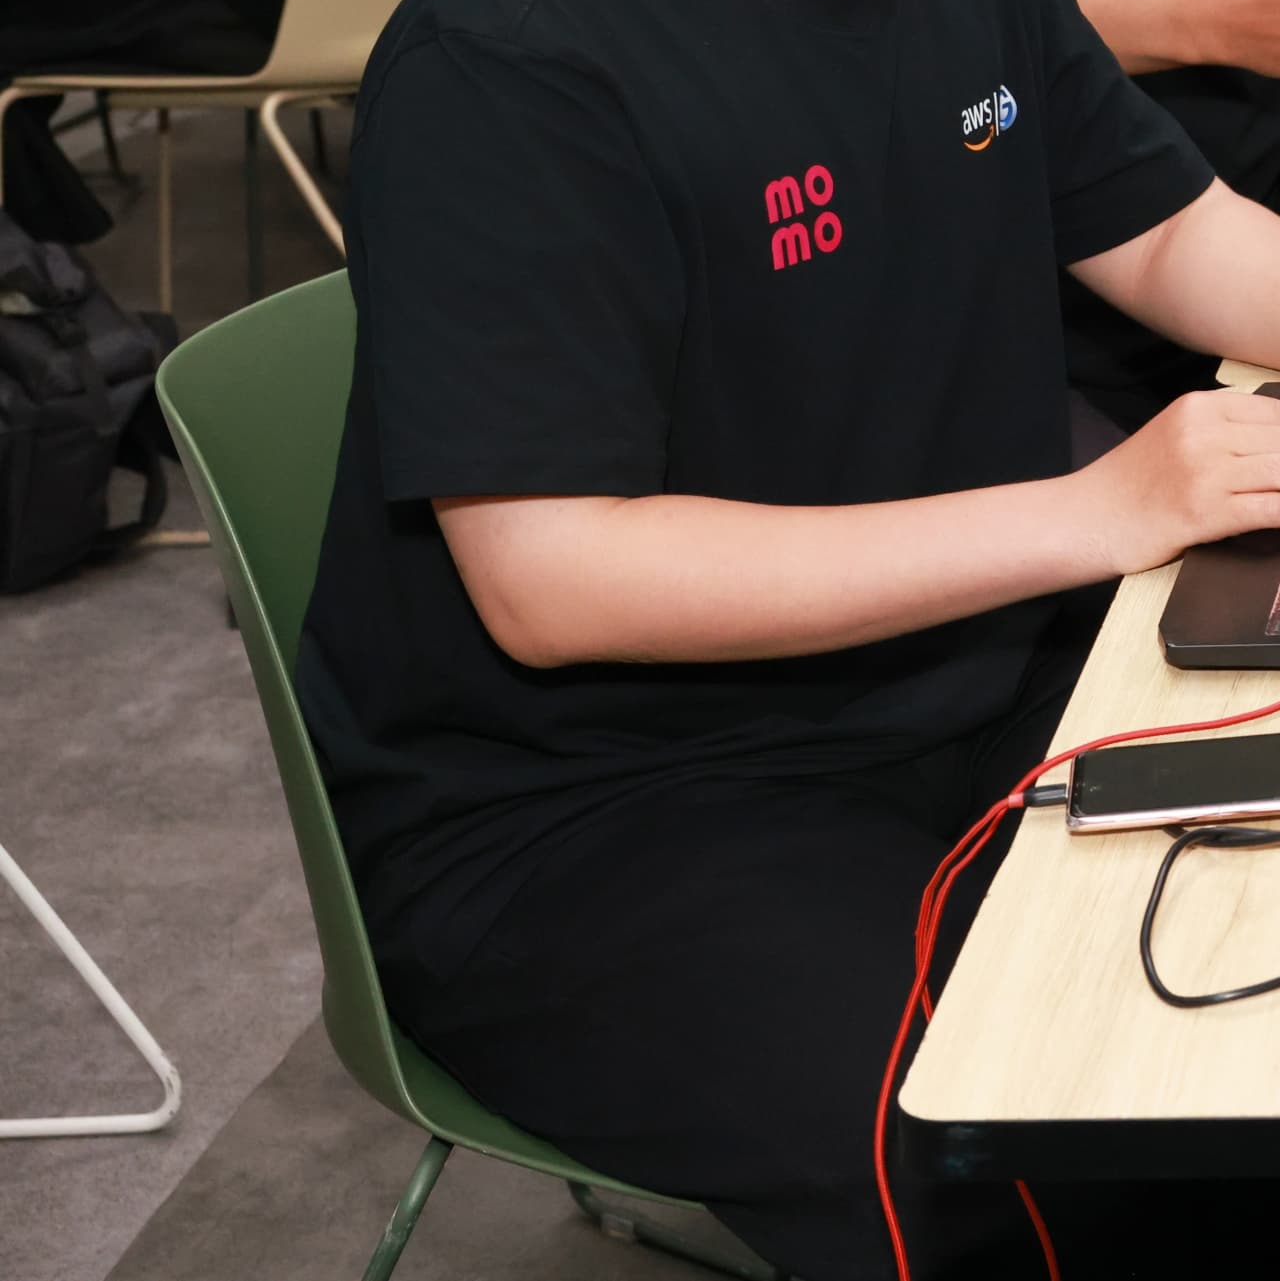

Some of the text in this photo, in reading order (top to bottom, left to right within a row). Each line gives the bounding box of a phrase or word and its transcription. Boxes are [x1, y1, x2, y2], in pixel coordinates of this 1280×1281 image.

[962, 98, 992, 136] aws
[764, 165, 834, 224] mo
[771, 211, 842, 270] mo
